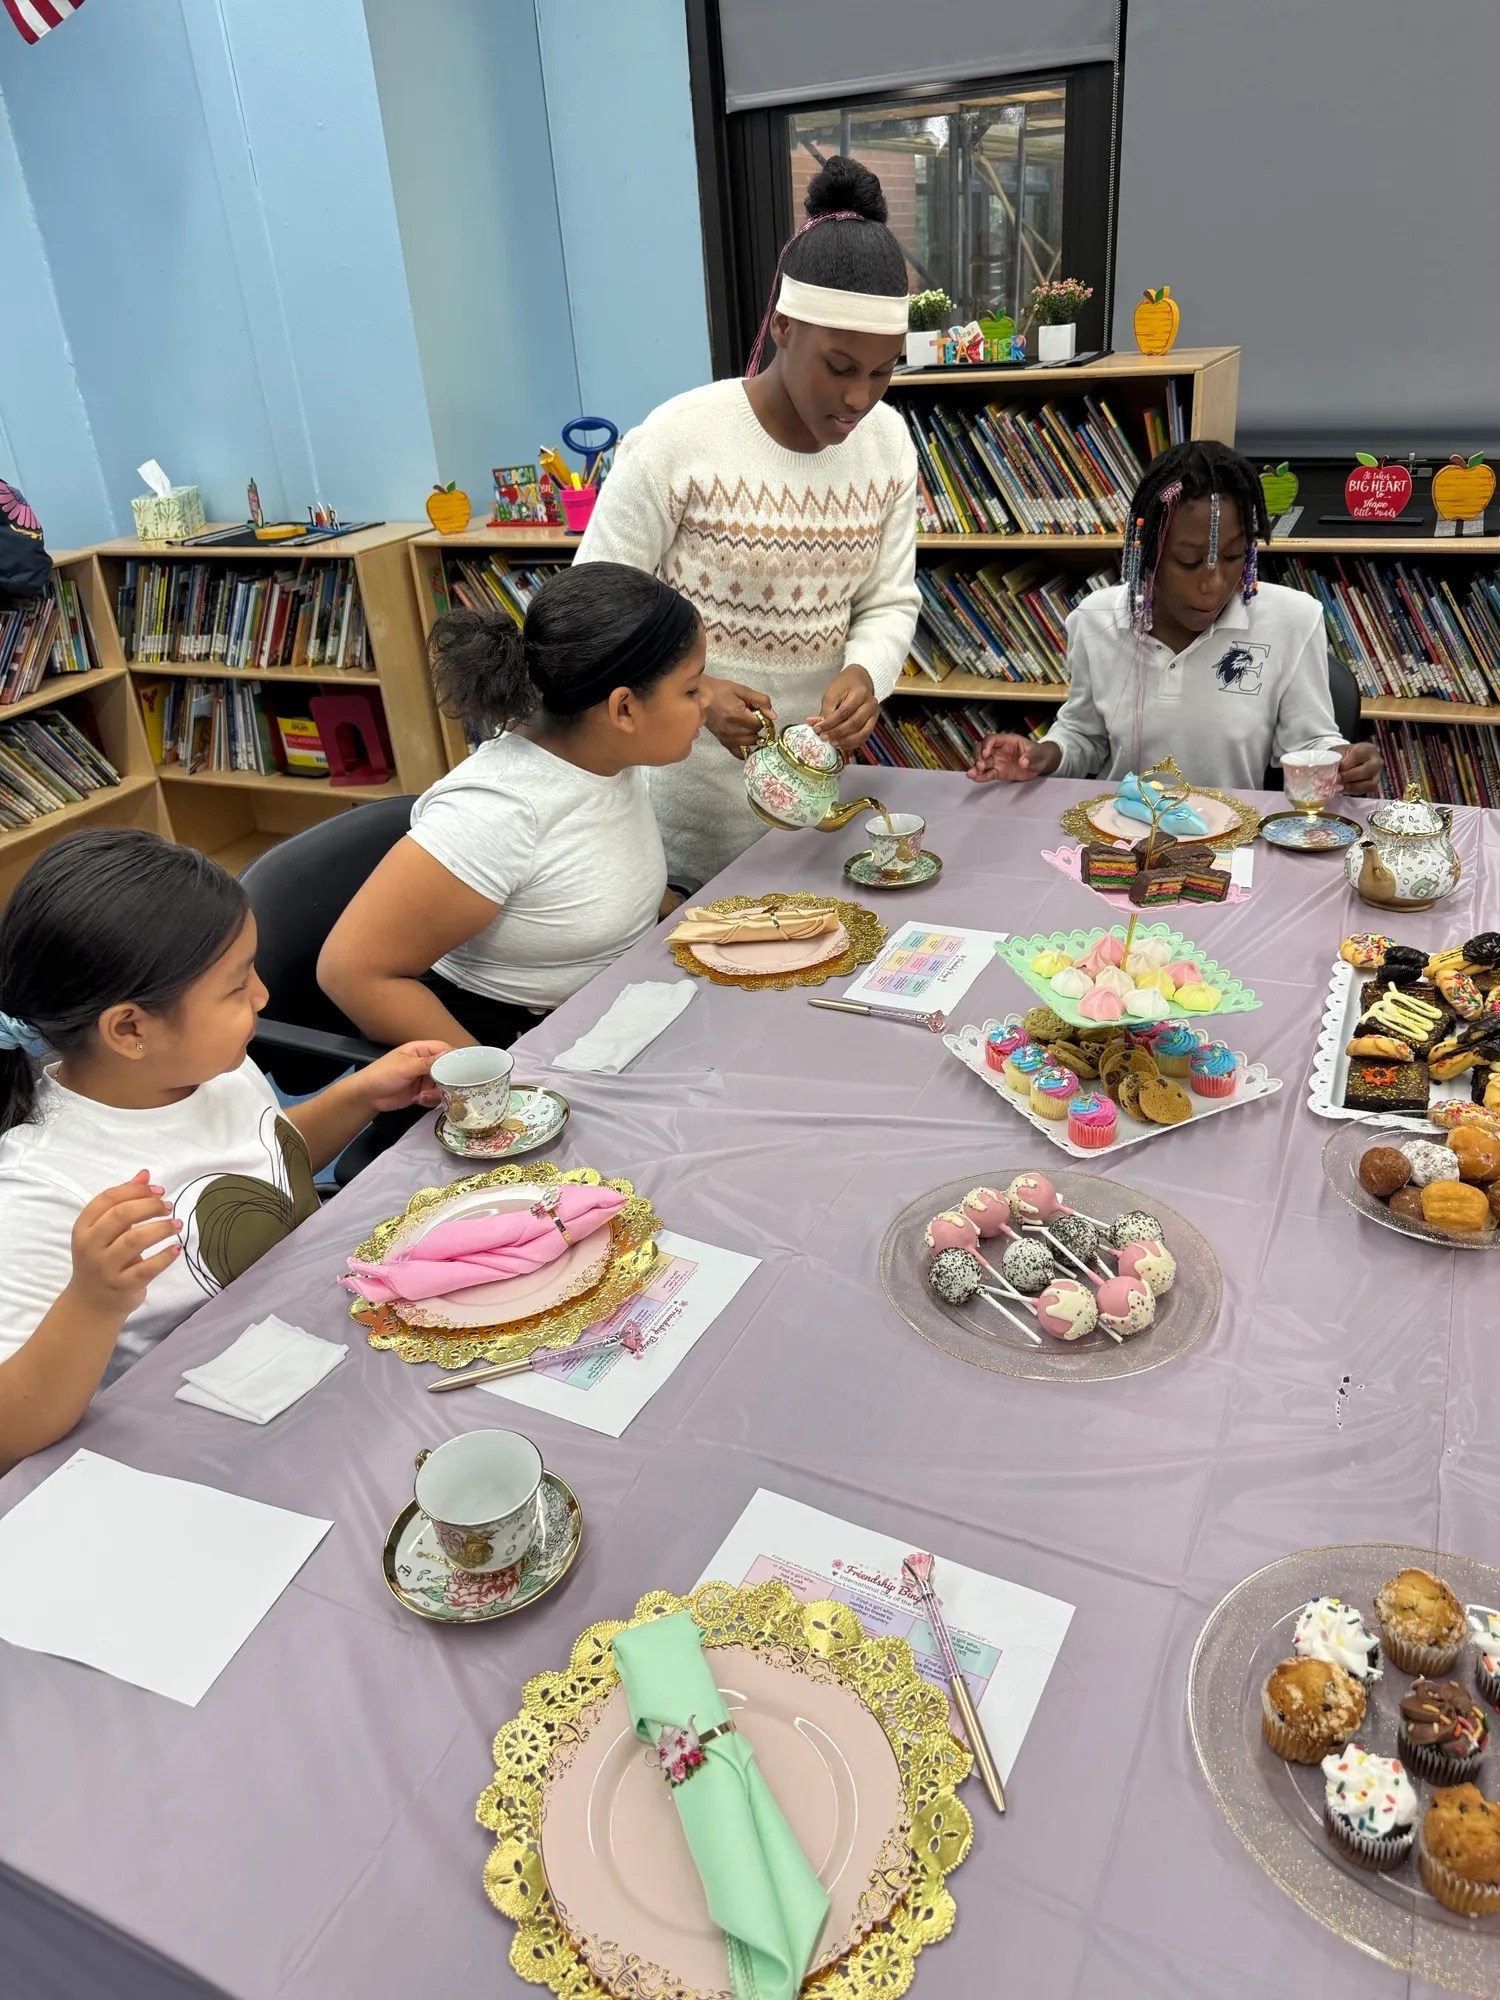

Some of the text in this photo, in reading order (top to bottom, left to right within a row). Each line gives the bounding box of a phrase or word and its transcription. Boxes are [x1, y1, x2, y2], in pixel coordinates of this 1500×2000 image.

[495, 467, 536, 486] TEACH
[1349, 480, 1408, 492] BIG HEART
[1363, 498, 1388, 511] shape
[1353, 507, 1396, 518] little minds
[840, 1575, 879, 1593] International
[880, 1590, 892, 1600] Day
[901, 1599, 911, 1607] the
[844, 1565, 921, 1606] Friendship Bing
[856, 1597, 868, 1605] Find
[849, 1601, 864, 1609] wants
[871, 1609, 885, 1618] travel
[869, 1614, 889, 1625] country
[965, 1646, 981, 1655] food?
[924, 1659, 937, 1667] Find
[925, 1672, 942, 1681] cream
